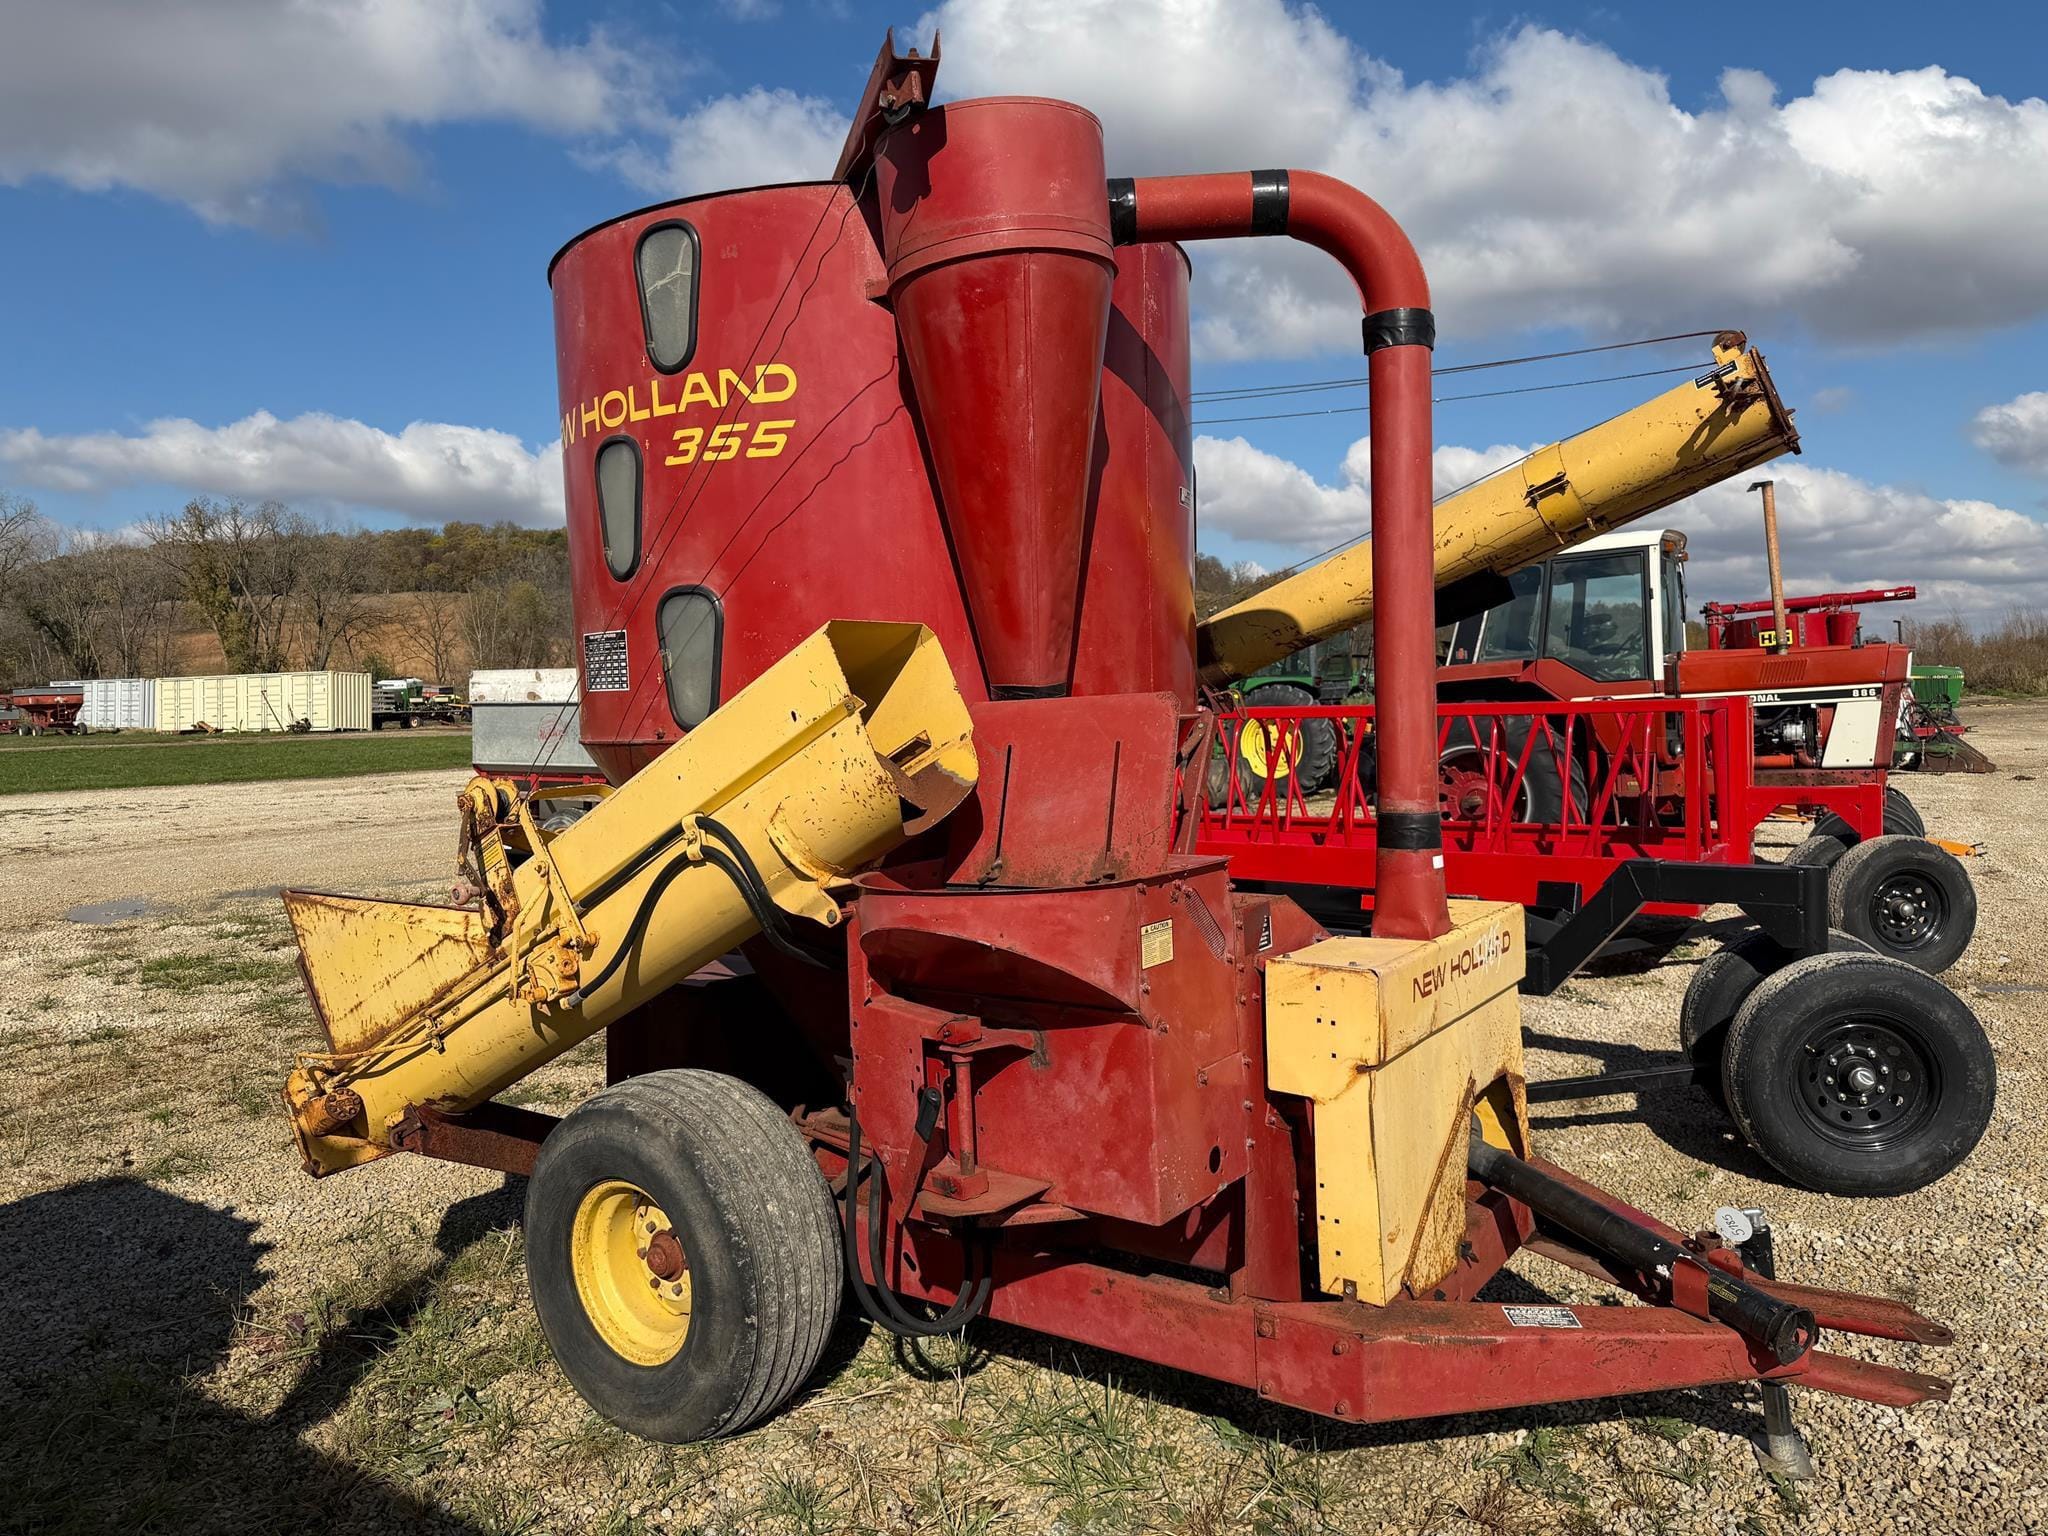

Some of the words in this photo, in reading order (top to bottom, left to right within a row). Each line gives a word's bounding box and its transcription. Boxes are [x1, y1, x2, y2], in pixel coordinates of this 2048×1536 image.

[581, 363, 798, 437] HOLLAND
[664, 419, 796, 466] 355
[1150, 921, 1169, 932] CAUTION
[1412, 961, 1446, 1003] NEW
